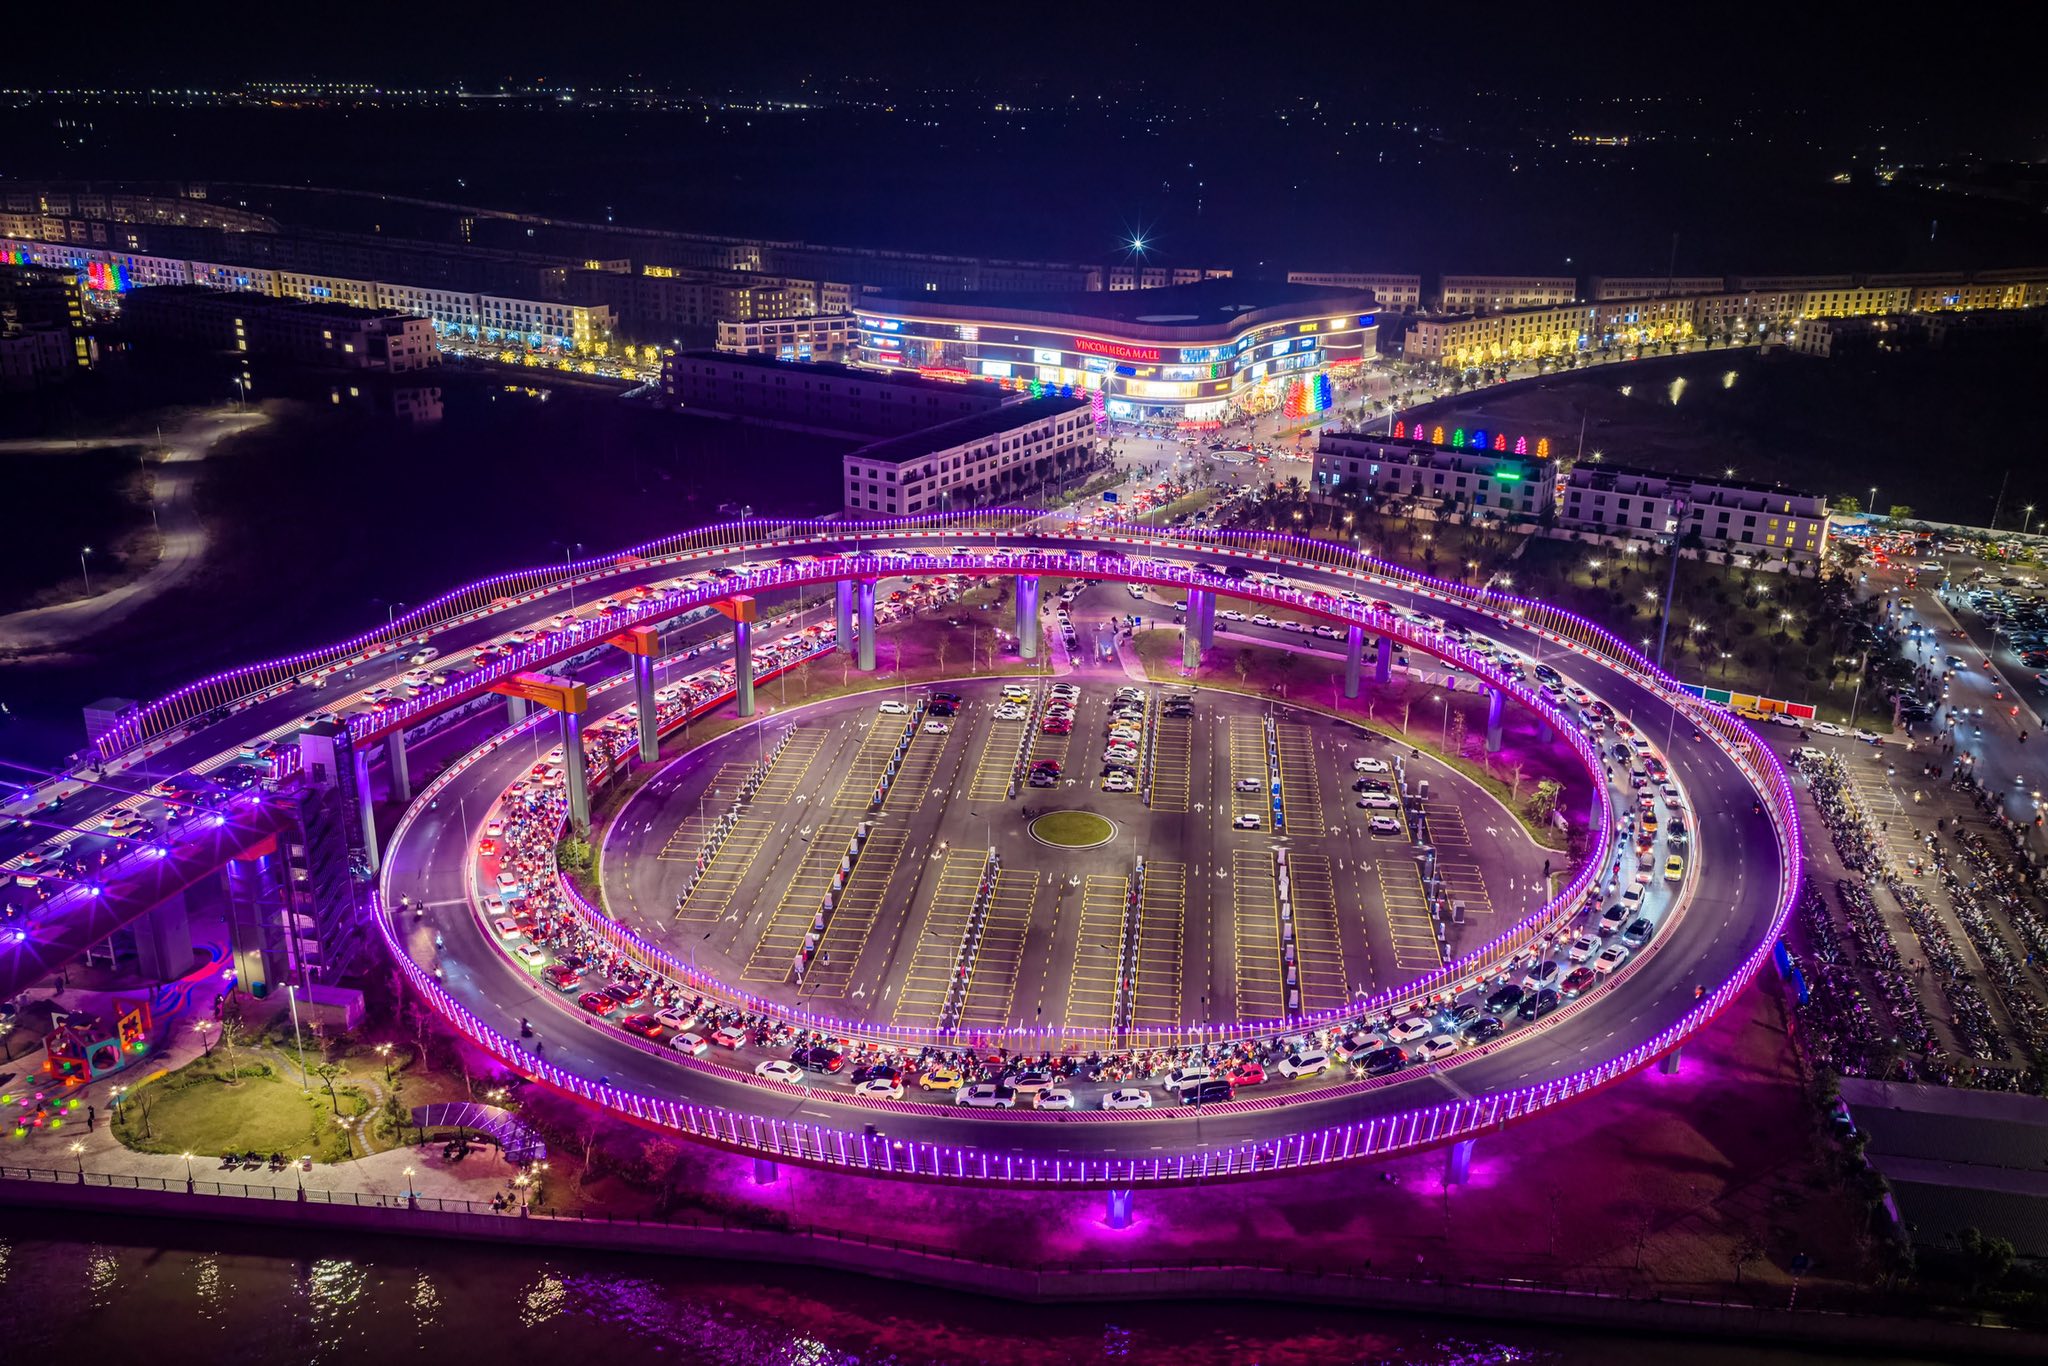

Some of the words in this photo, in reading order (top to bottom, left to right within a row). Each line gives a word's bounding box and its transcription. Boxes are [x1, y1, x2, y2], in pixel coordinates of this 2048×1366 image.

[1076, 339, 1108, 354] VINCOM
[1109, 345, 1132, 357] MEGA
[1133, 349, 1160, 360] MALL
